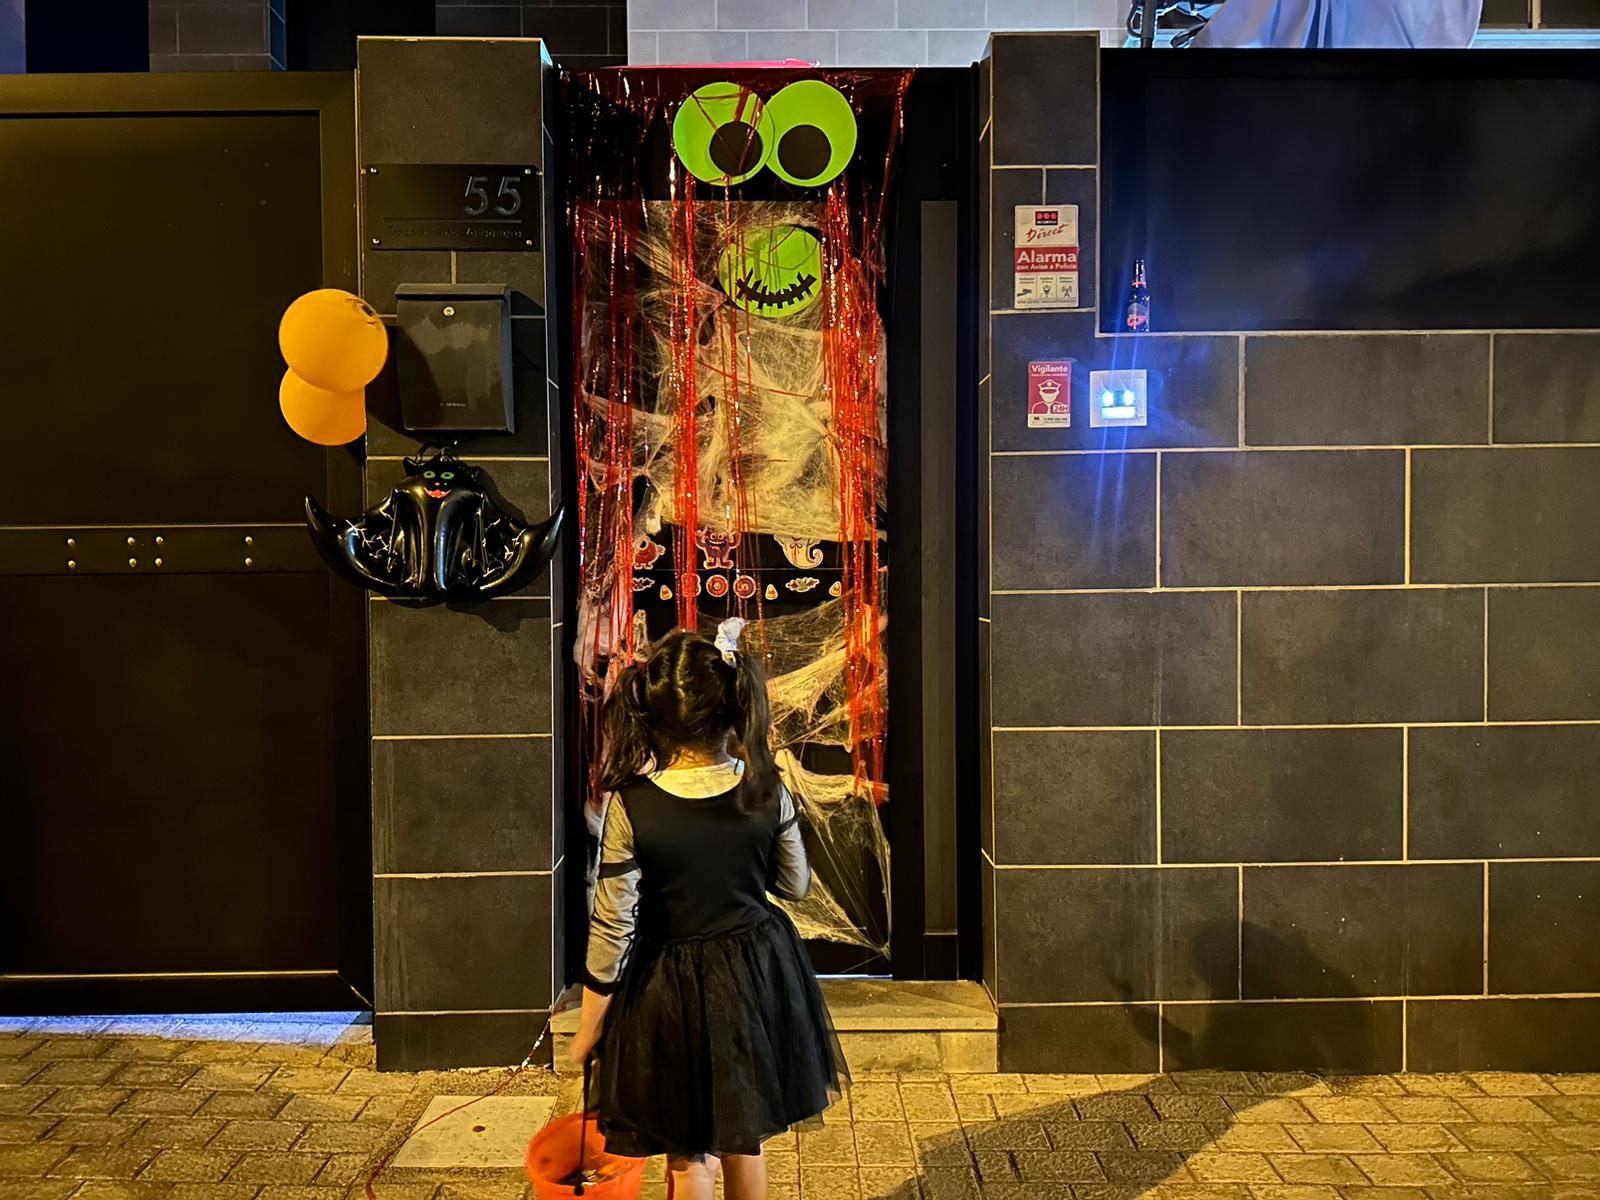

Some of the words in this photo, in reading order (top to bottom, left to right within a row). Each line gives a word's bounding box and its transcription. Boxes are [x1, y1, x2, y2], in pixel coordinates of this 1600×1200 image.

[464, 175, 522, 216] 55
[1026, 223, 1069, 243] Direct
[1017, 250, 1077, 263] Alarma
[1031, 364, 1069, 374] Vigilante
